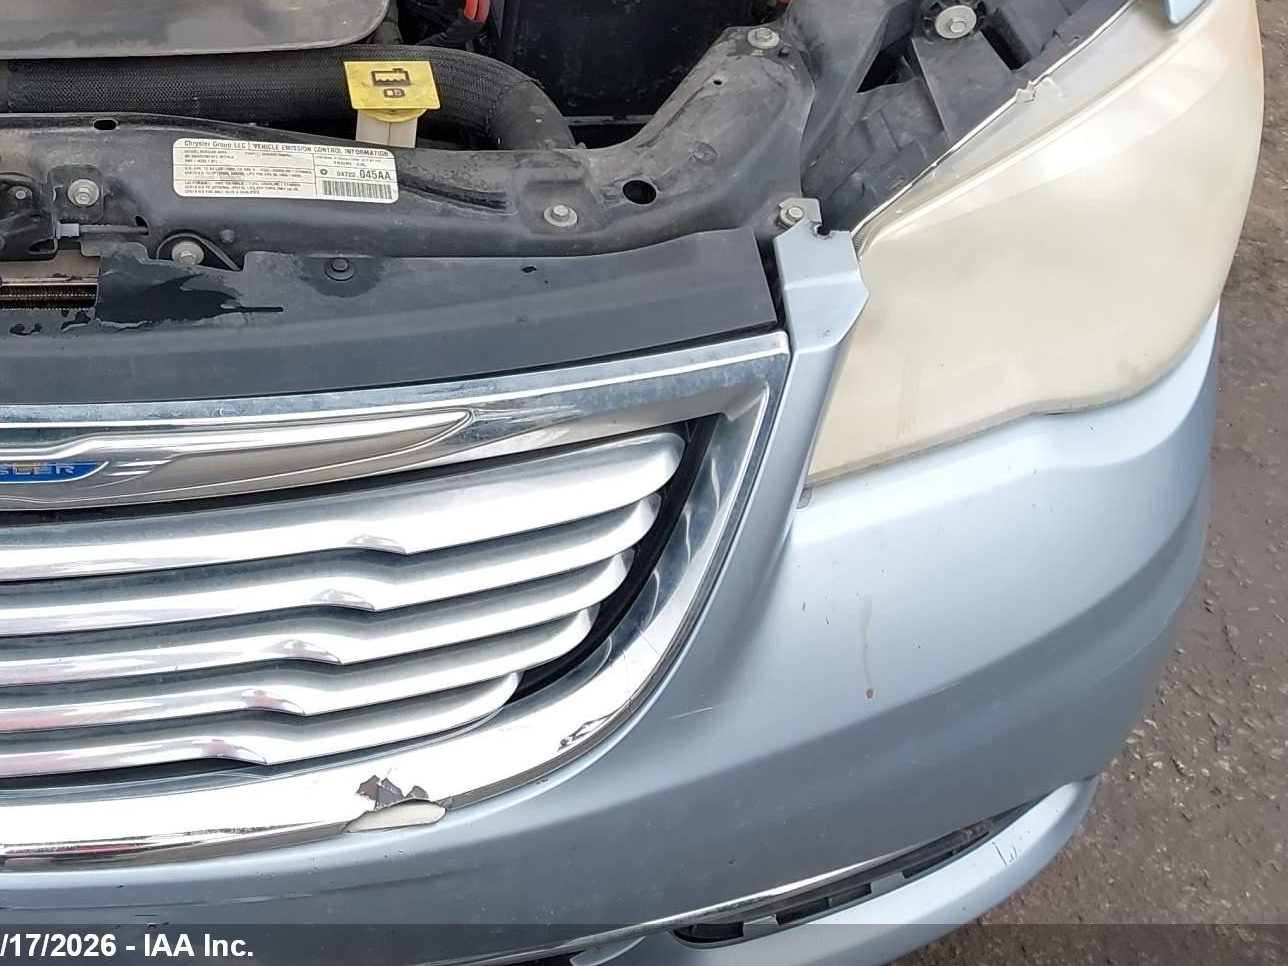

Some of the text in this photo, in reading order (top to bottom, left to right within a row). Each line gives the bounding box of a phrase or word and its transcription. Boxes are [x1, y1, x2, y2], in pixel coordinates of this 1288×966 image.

[213, 141, 232, 149] Group
[314, 146, 343, 154] CONTROL
[345, 148, 389, 157] INFORMATION
[359, 169, 392, 180] 045AA
